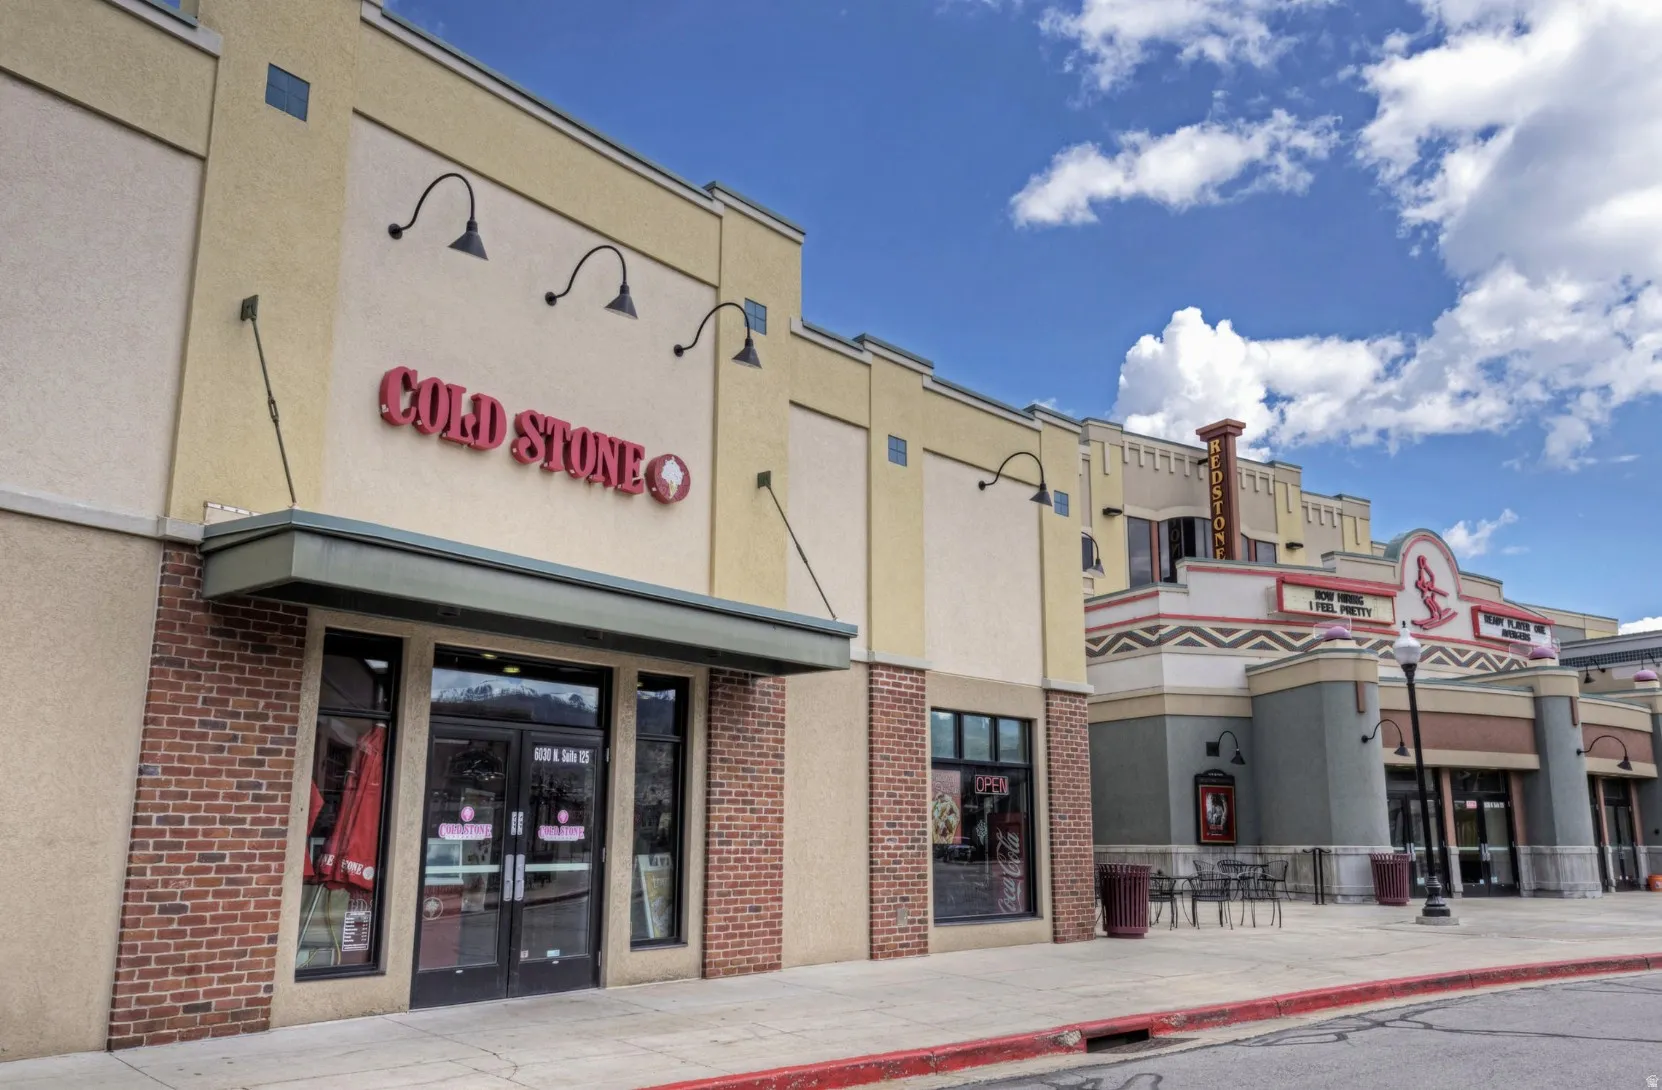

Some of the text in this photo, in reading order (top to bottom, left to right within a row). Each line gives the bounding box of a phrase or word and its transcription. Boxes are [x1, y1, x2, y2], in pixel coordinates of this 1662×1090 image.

[379, 366, 645, 494] COLD STONE
[1209, 439, 1226, 559] REDSTONE
[1314, 589, 1364, 605] NOW HIRING
[1309, 600, 1372, 618] I FEEL PRETTY
[1484, 614, 1504, 626] READY
[1507, 620, 1530, 631] PLAYER
[534, 747, 590, 764] 6030 N. Suite 125
[976, 776, 1008, 793] OPEN
[439, 823, 493, 838] COLD STONE
[538, 826, 585, 839] COLD STONE
